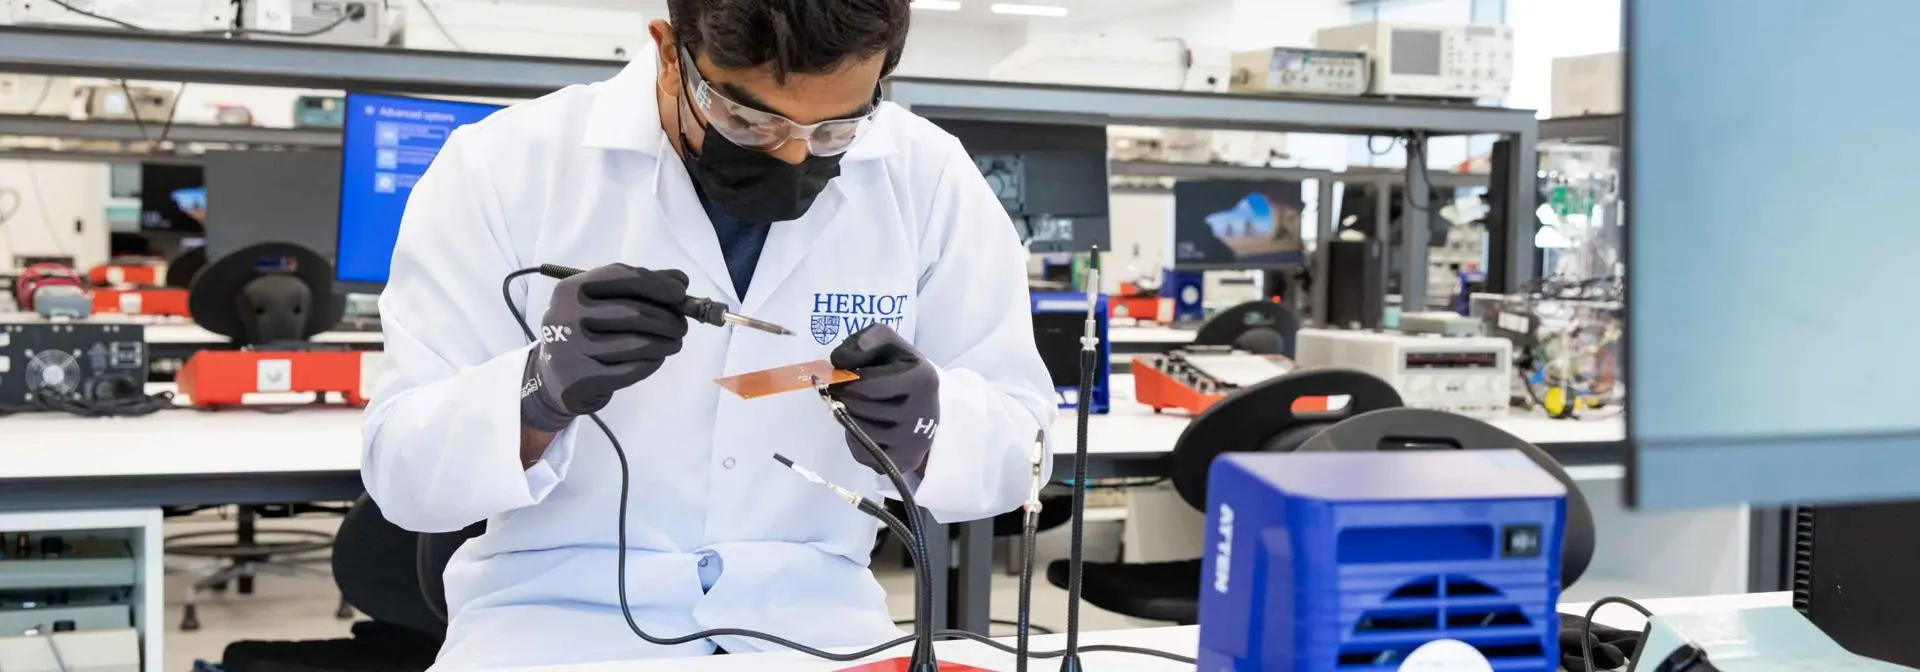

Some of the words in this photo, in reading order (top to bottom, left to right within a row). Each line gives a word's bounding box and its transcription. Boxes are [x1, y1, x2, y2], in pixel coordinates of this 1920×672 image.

[379, 106, 422, 120] Advanced
[423, 111, 455, 124] options
[812, 293, 908, 315] HERIOT
[1214, 502, 1234, 594] ATTEN
